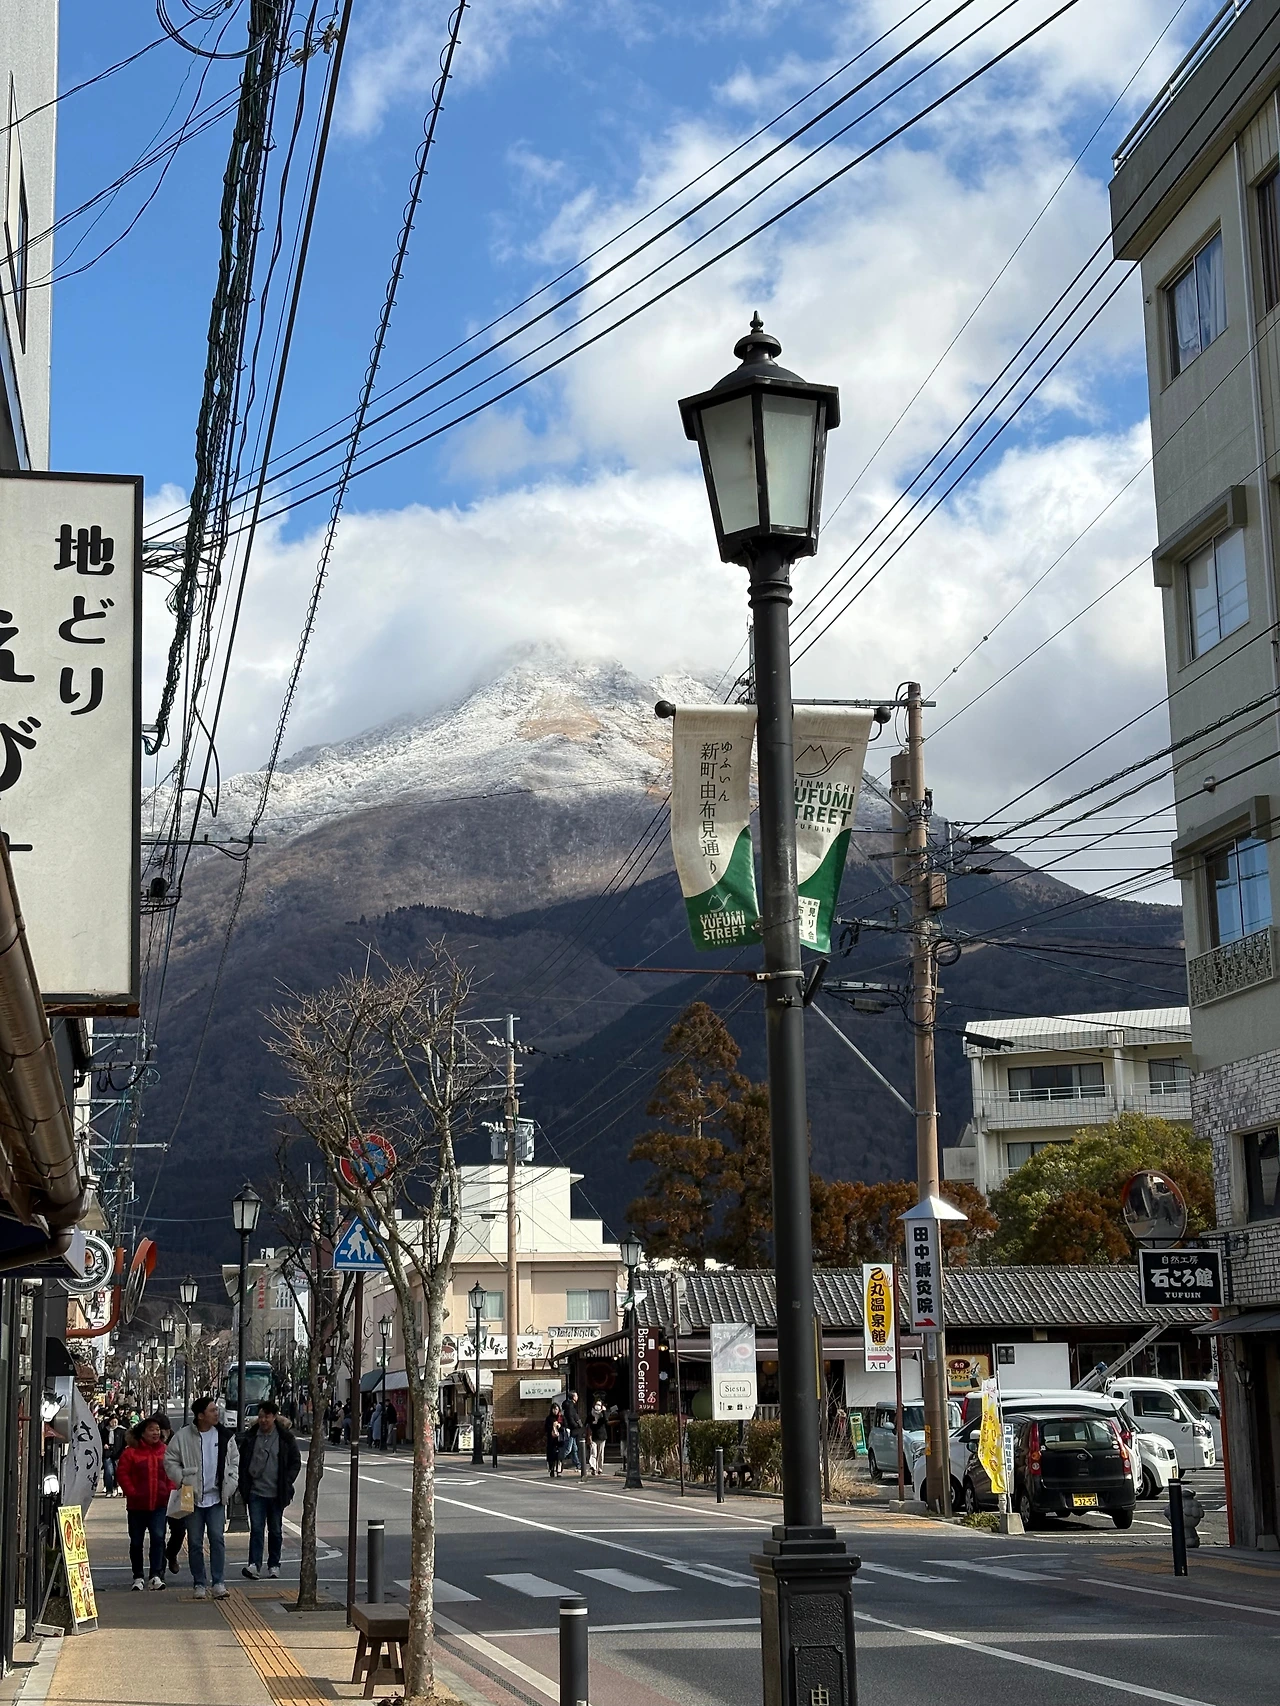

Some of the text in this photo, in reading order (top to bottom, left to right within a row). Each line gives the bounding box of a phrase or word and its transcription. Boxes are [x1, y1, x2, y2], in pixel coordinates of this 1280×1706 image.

[54, 524, 115, 716] 地どり
[718, 741, 733, 802] ゆふいん
[794, 779, 856, 793] HINMACHI
[698, 742, 721, 875] 新町由布見通り
[794, 786, 855, 810] UFUMI
[794, 804, 852, 827] TREET
[700, 914, 746, 930] YUFUMI
[703, 925, 746, 941] STREET
[913, 1226, 934, 1314] 田中鍼灸院
[1161, 1255, 1199, 1265] 自然工房
[1150, 1267, 1214, 1288] 石ころ館
[869, 1267, 886, 1344] 乙丸温泉館
[1164, 1291, 1202, 1299] YUFUIN
[638, 1328, 650, 1404] Bistro Cerisier
[870, 1361, 886, 1370] 入口
[724, 1385, 746, 1393] Siesta
